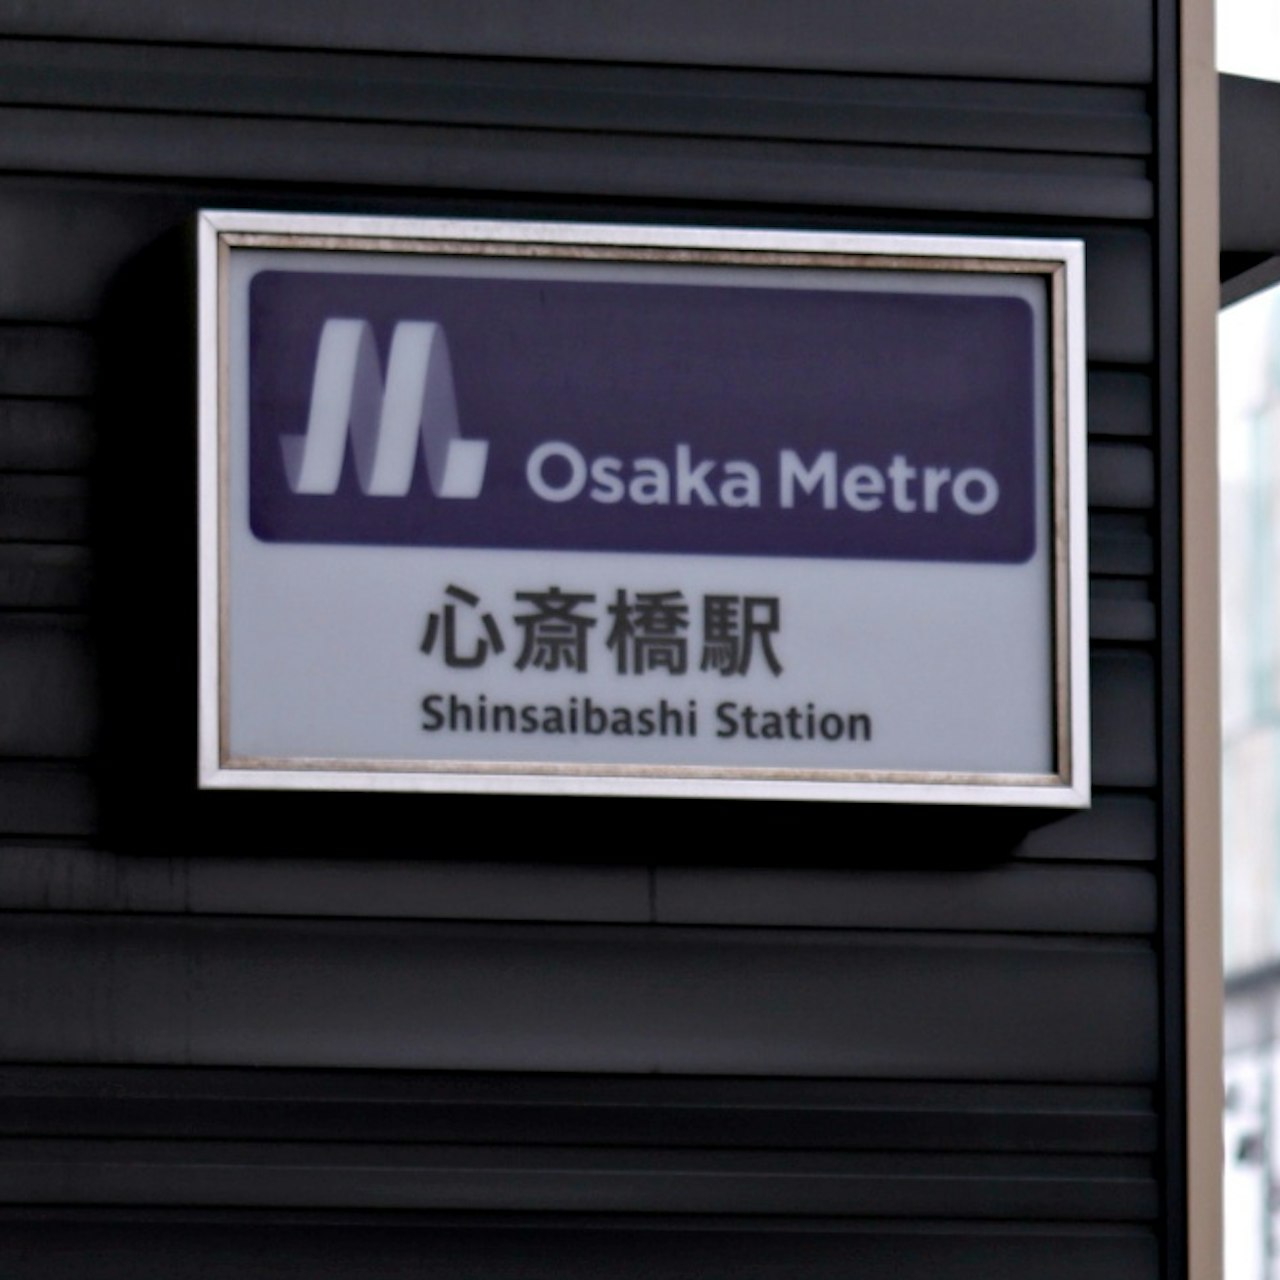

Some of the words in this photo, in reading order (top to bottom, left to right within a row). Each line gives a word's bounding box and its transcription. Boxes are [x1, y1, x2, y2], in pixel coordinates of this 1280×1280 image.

[525, 441, 761, 508] Osaka
[780, 449, 999, 515] Metro
[420, 584, 782, 677] 心斎橋駅
[420, 695, 697, 737] Shinsaibashi
[715, 702, 872, 741] Station
